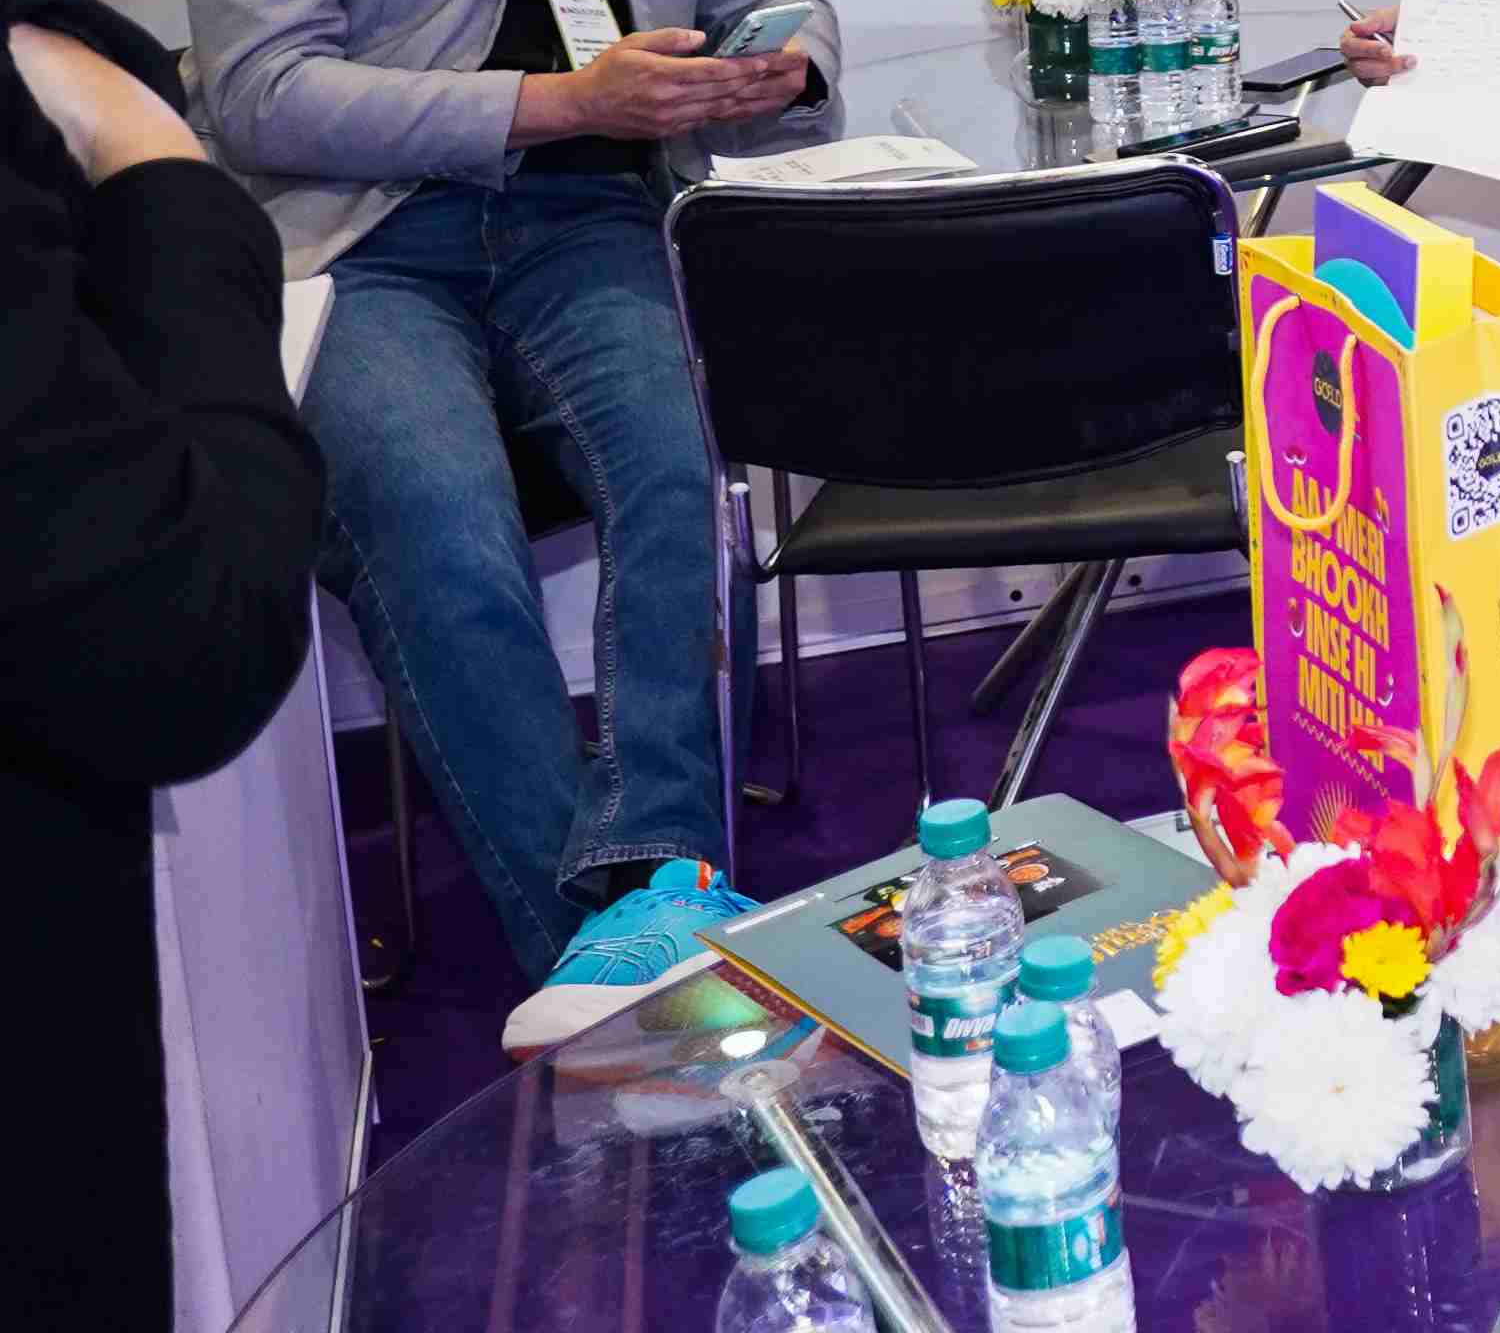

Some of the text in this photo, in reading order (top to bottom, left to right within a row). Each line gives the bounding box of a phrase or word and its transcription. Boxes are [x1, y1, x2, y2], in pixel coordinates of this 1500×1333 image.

[1292, 529, 1390, 653] BHOOKH
[1335, 502, 1386, 586] MERI
[1304, 596, 1377, 704] INSE HI
